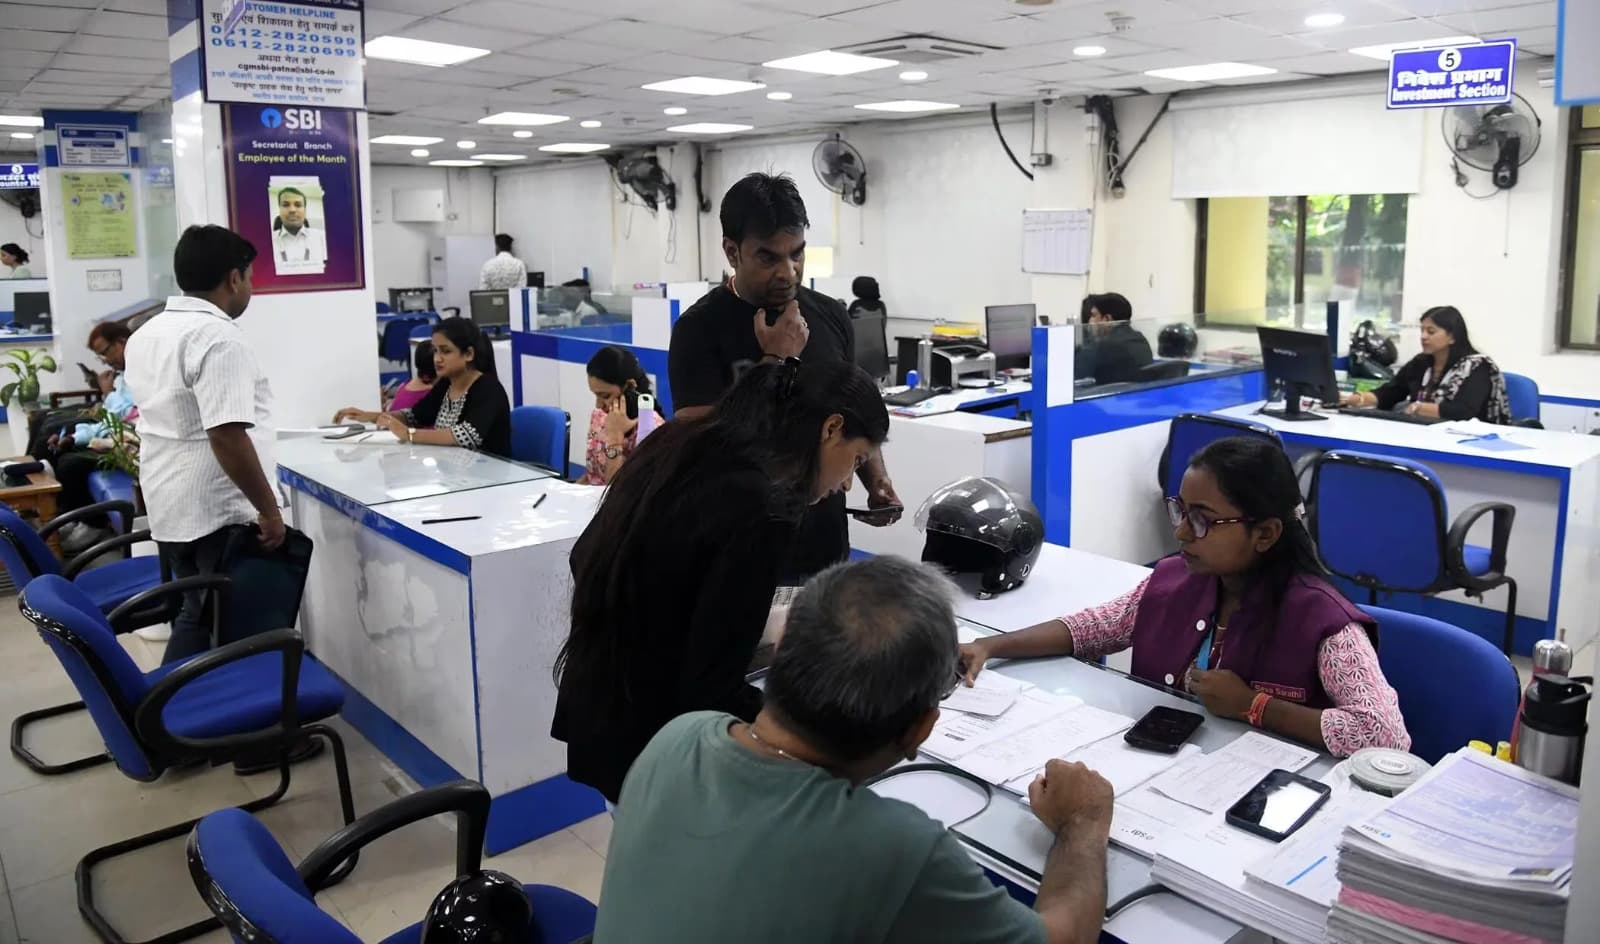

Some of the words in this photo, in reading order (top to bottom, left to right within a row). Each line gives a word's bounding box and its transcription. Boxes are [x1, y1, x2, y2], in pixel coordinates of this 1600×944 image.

[245, 3, 286, 14] STOMER
[289, 7, 336, 19] HELPLINE
[257, 14, 293, 28] शिकायत
[297, 18, 310, 32] हेतु
[1445, 52, 1455, 68] 5
[1392, 85, 1456, 102] Investment
[1458, 82, 1506, 98] Section
[284, 108, 322, 130] SBI
[252, 140, 297, 150] Secretariat
[303, 141, 333, 150] Branch
[238, 153, 285, 163] Employee
[287, 154, 297, 162] of
[299, 154, 314, 163] the
[317, 154, 346, 163] Month
